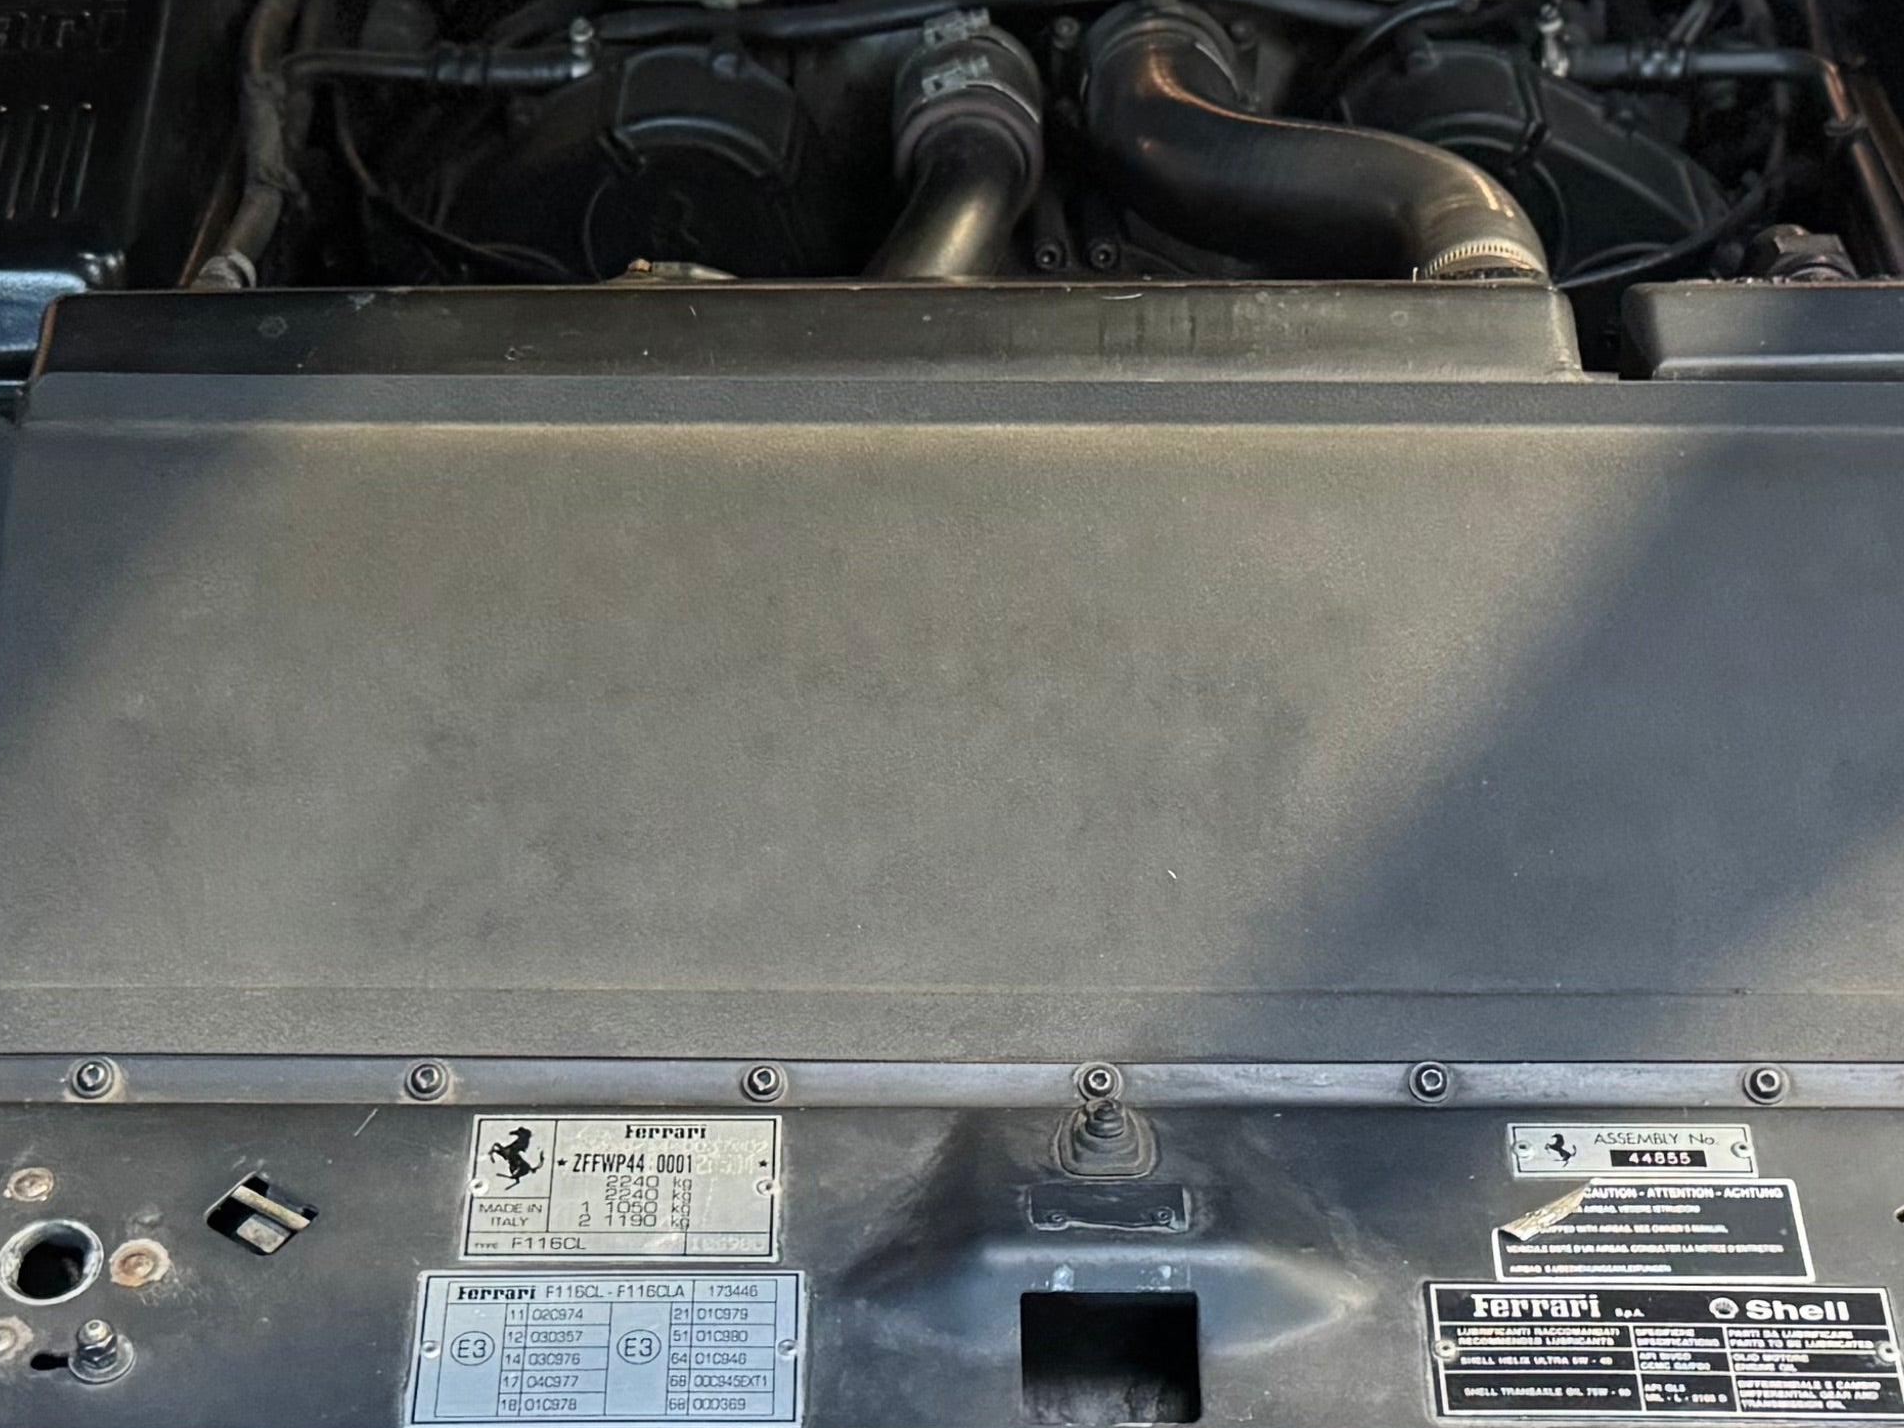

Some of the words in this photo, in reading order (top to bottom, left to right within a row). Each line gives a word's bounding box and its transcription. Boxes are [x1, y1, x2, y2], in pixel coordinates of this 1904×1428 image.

[625, 1123, 707, 1139] Ferrari
[1594, 1133, 1678, 1145] ASSEMBLY
[572, 1153, 645, 1173] ZFFWP44
[1629, 1152, 1692, 1165] 44855
[605, 1175, 659, 1188] 2240
[673, 1175, 693, 1191] kg
[604, 1188, 659, 1201] 2240
[671, 1188, 692, 1204] kg
[1584, 1187, 1637, 1199] CAUTION
[1648, 1187, 1714, 1199] ATTENTION
[1724, 1187, 1784, 1199] ACHTUNG
[479, 1203, 523, 1214] MADE
[527, 1203, 543, 1214] IN
[606, 1201, 658, 1214] 1050
[671, 1201, 691, 1217] kg
[490, 1216, 529, 1227] ITALY
[578, 1214, 591, 1227] 2
[605, 1214, 657, 1227] 1190
[511, 1237, 587, 1251] F116CL
[457, 1285, 536, 1300] Ferrari
[546, 1285, 604, 1299] F116CL
[617, 1284, 685, 1298] F116CLA
[709, 1284, 758, 1297] 173446
[1471, 1293, 1601, 1318] Ferrari
[1746, 1299, 1850, 1322] Shell
[510, 1309, 524, 1320] 11
[673, 1308, 689, 1320] 21
[508, 1331, 523, 1343] 12
[672, 1330, 688, 1341] 51
[457, 1338, 487, 1359] E3
[624, 1337, 653, 1358] E3
[505, 1353, 521, 1364] 14
[671, 1352, 688, 1364] 64
[503, 1376, 519, 1388] 17
[500, 1399, 516, 1411] 18
